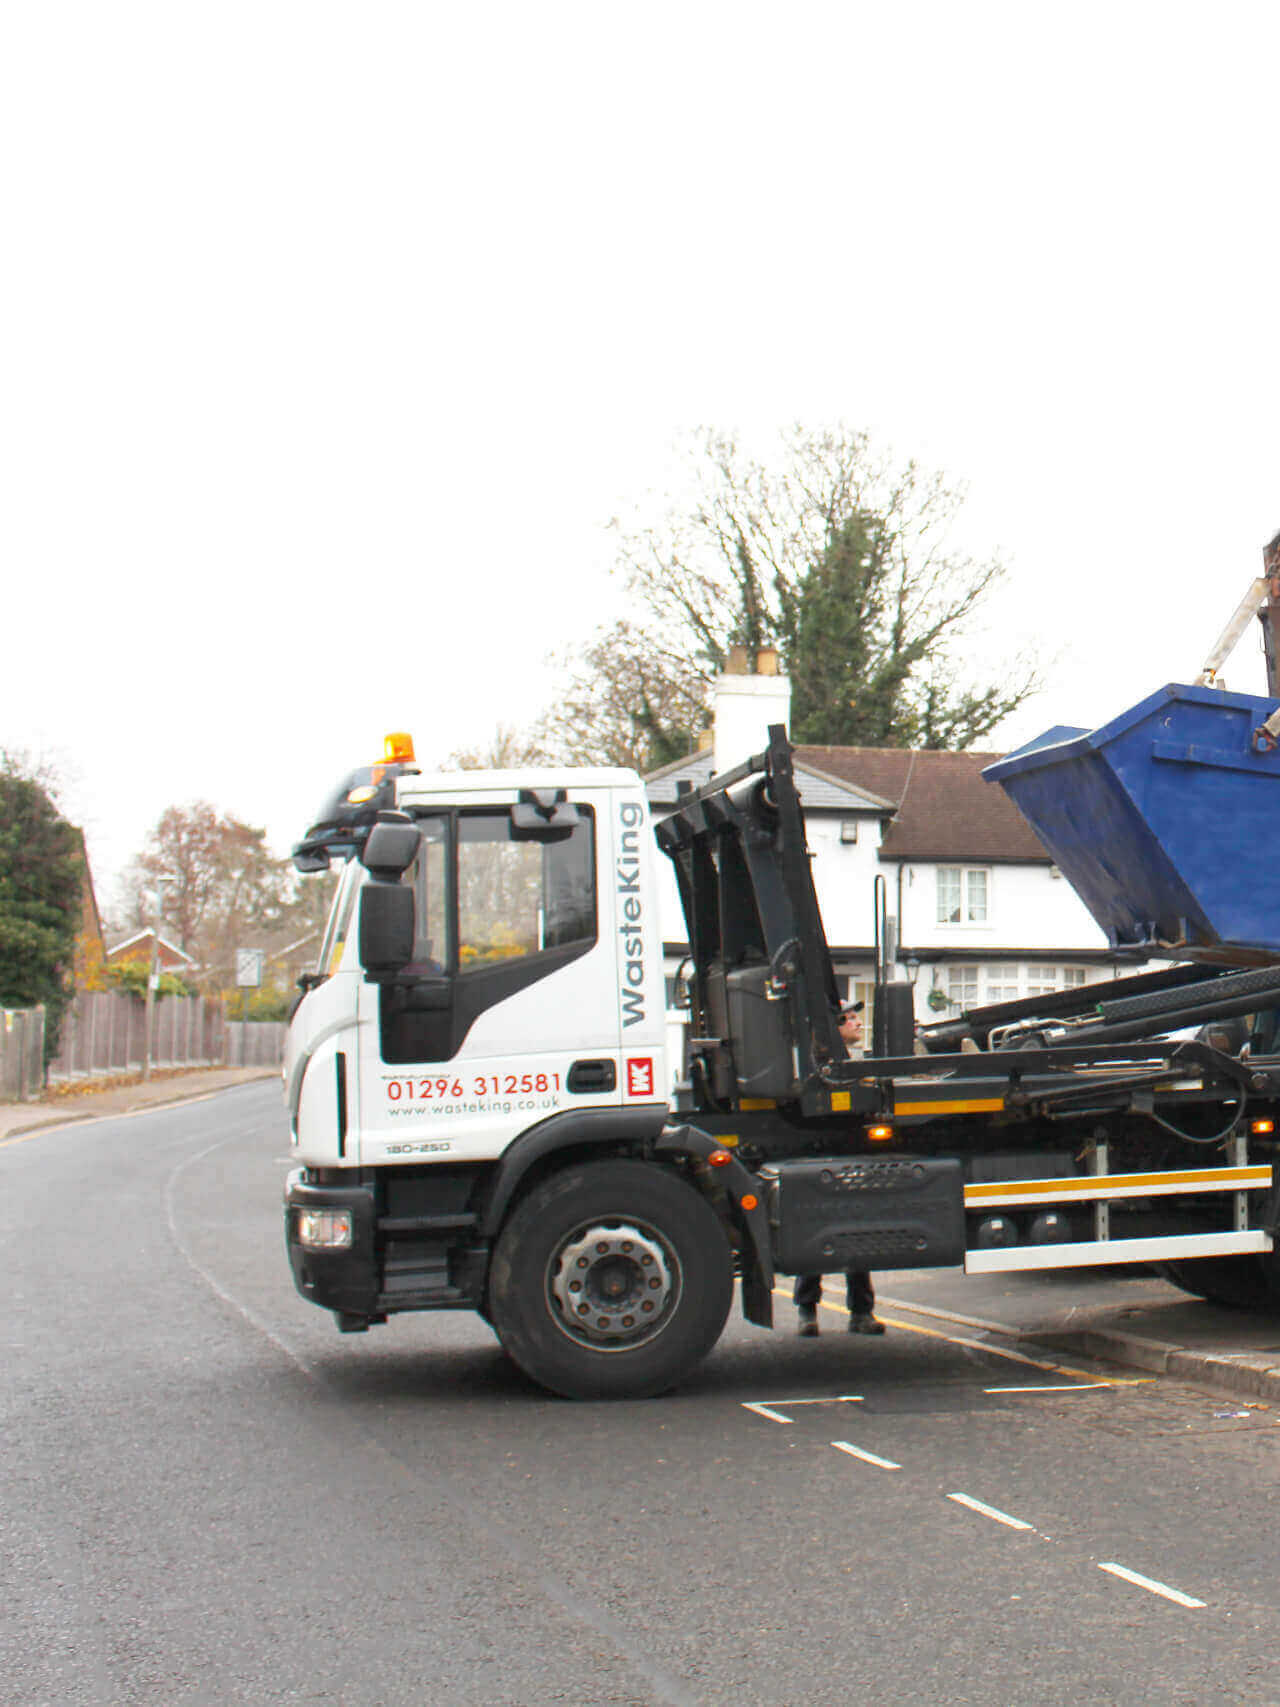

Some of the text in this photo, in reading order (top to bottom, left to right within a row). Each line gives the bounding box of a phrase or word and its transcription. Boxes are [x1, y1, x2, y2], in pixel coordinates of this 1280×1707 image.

[617, 802, 646, 1028] WasteKing
[387, 1072, 561, 1101] 01296 312581
[630, 1063, 651, 1092] WK
[388, 1096, 560, 1118] www.wasteking.co.uk
